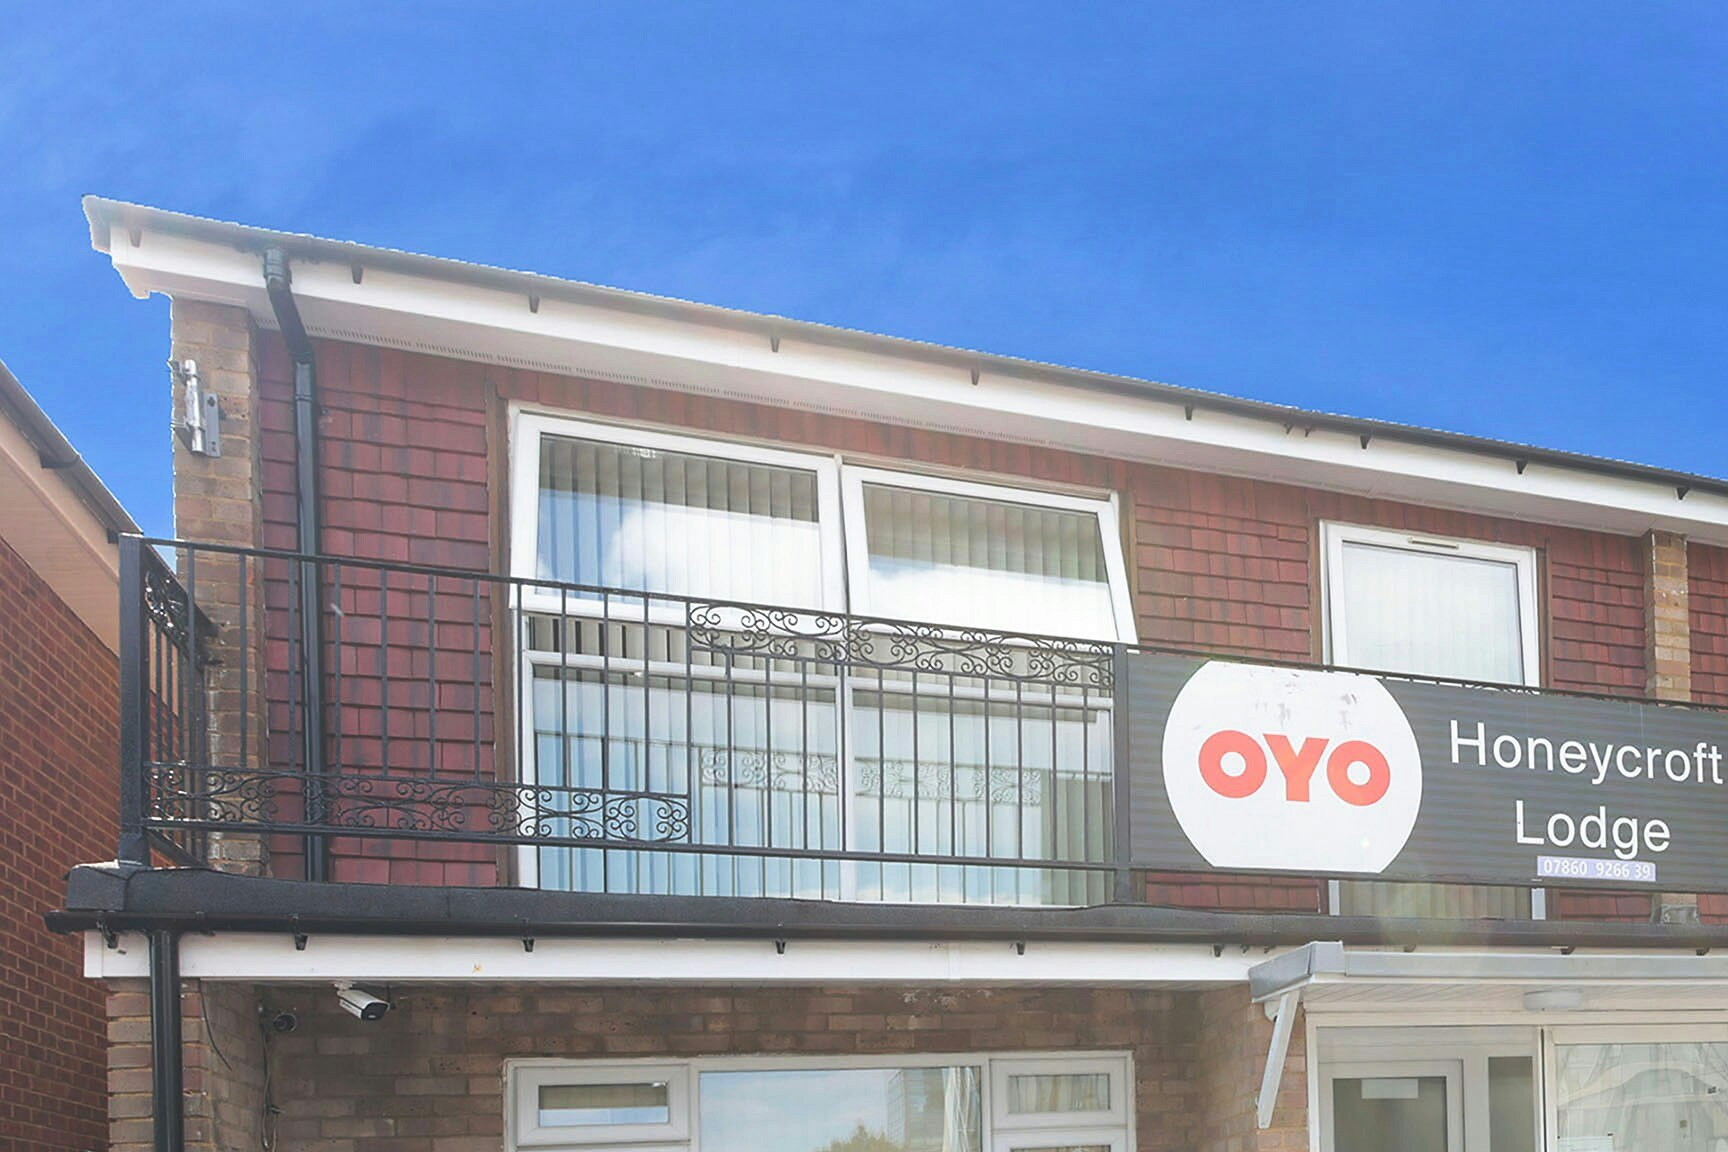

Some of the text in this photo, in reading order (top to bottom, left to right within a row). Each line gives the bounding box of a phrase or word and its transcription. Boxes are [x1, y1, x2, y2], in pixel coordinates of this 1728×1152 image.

[1198, 730, 1391, 806] OYO
[1450, 719, 1723, 785] Honeycroft
[1516, 800, 1671, 860] Lodge
[1543, 858, 1651, 879] 07860 9266 39
